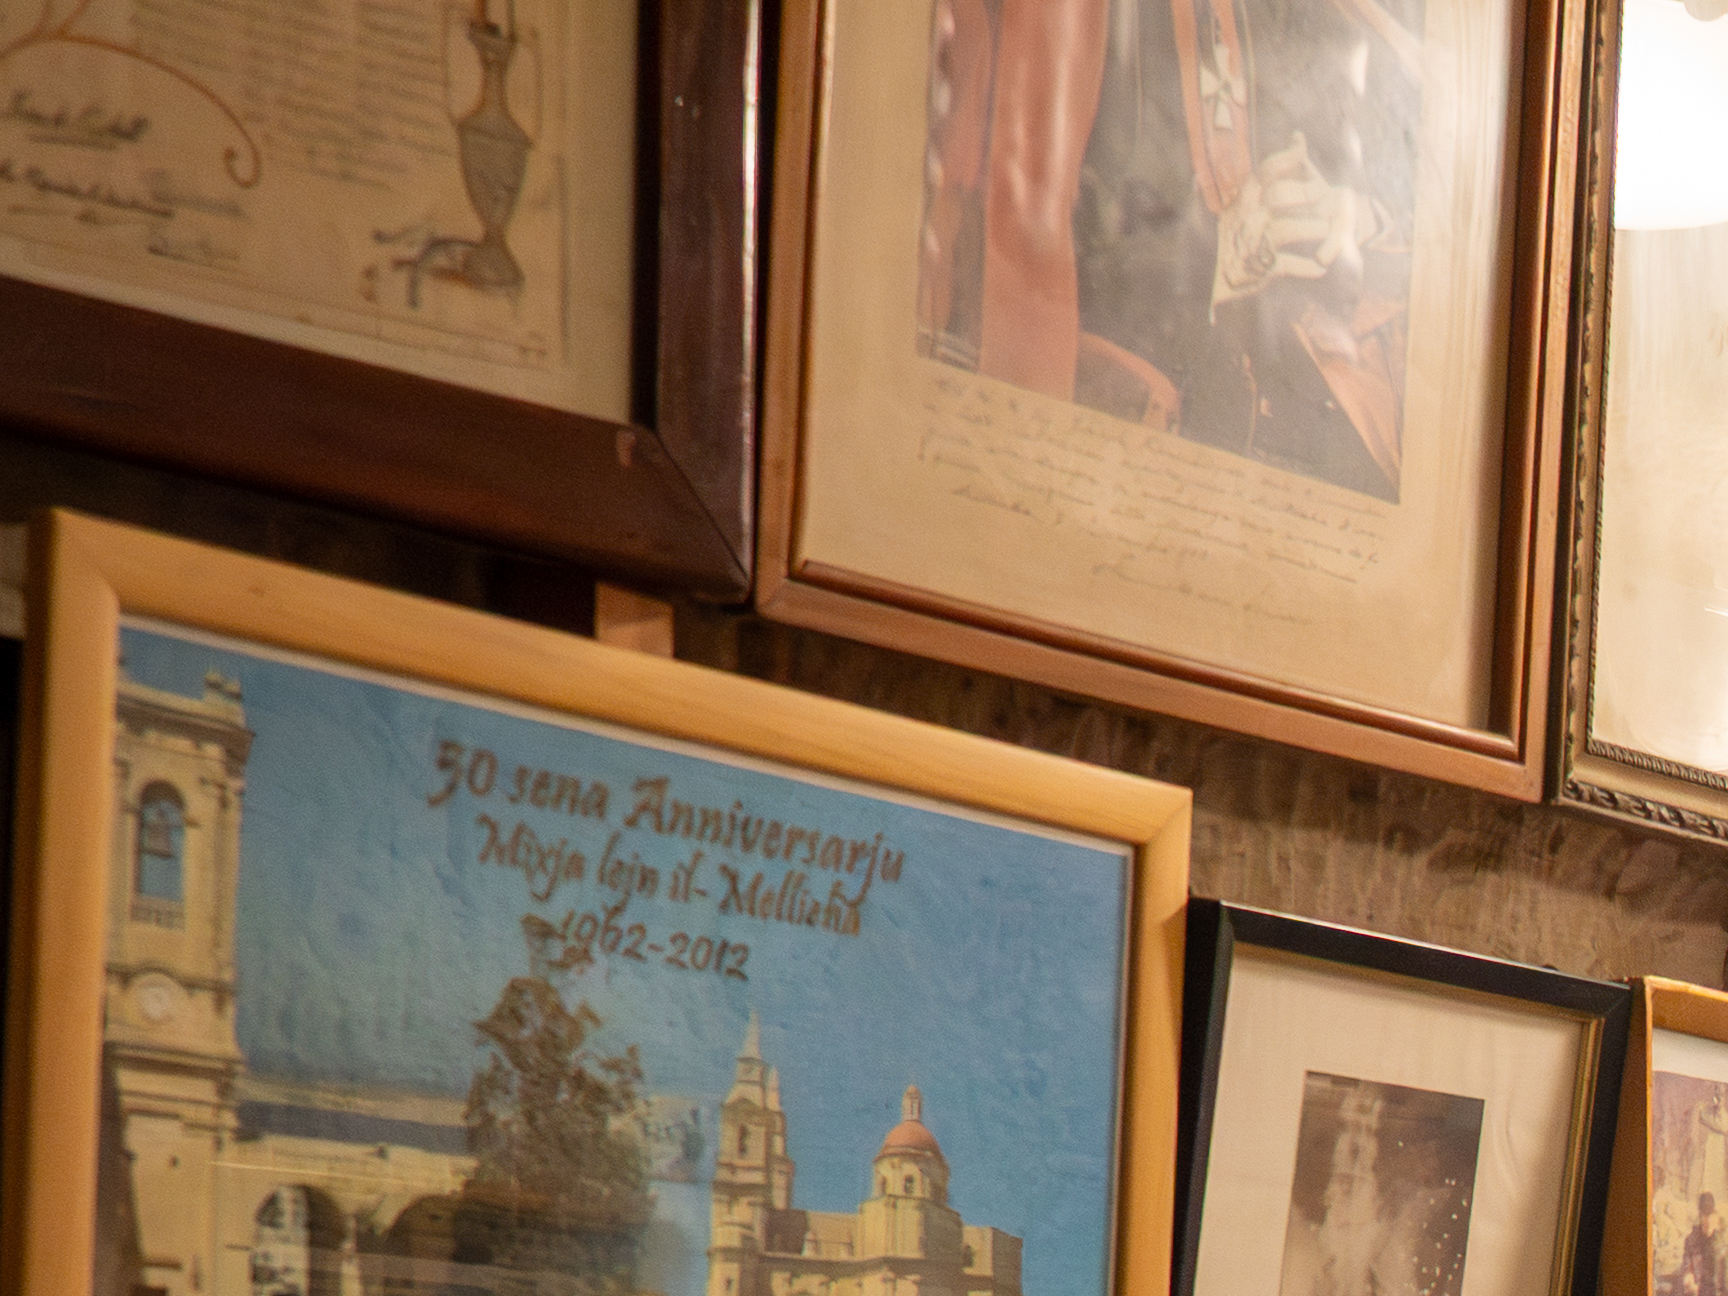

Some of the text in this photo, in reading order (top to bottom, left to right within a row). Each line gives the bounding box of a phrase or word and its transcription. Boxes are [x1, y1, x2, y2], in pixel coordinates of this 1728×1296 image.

[427, 739, 906, 907] 50 sena Anniversarju
[599, 832, 660, 912] lejn
[560, 909, 752, 982] 1962-2012
